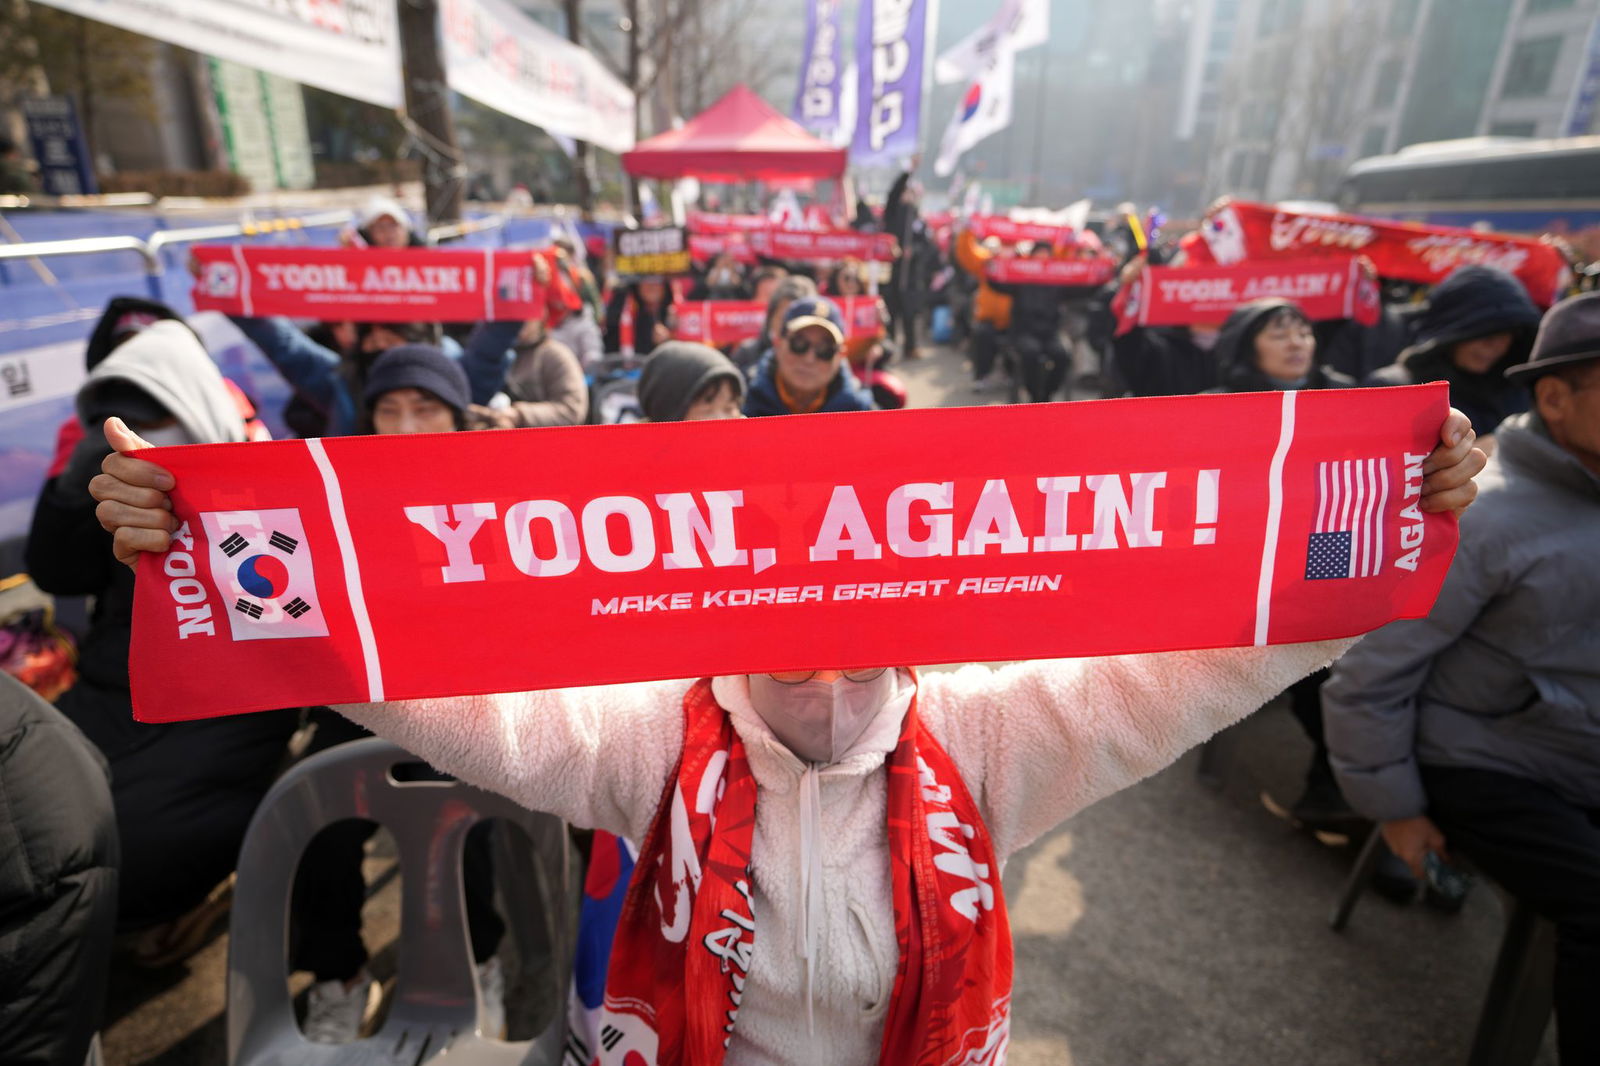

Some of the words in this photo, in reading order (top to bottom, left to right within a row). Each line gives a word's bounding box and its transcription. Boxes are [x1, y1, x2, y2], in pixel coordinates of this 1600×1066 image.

[362, 266, 461, 292] AGAIN
[403, 490, 776, 583] YOON,
[809, 472, 1167, 562] AGAIN
[1394, 452, 1430, 572] AGAIN
[591, 592, 693, 616] MAKE
[702, 585, 824, 608] KOREA
[833, 579, 950, 600] GREAT
[957, 574, 1062, 595] AGAIN
